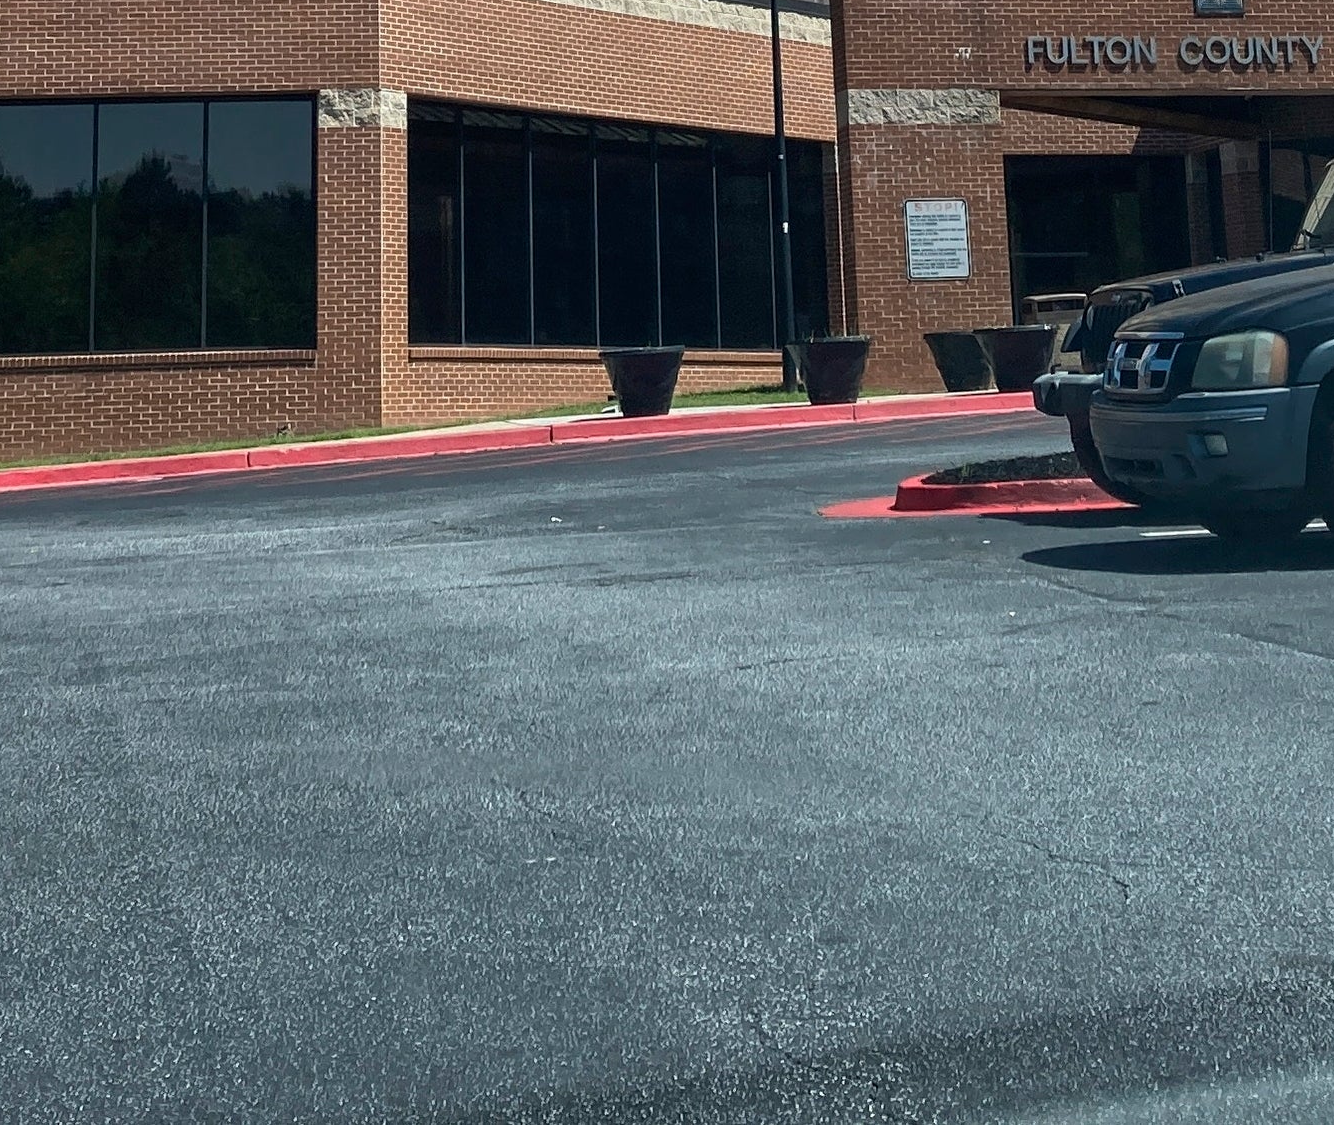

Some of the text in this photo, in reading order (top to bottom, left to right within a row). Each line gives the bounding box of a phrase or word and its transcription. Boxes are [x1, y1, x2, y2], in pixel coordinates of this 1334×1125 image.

[1027, 35, 1157, 64] FULTON
[1179, 35, 1324, 65] COUNTY
[914, 202, 958, 212] STOP!
